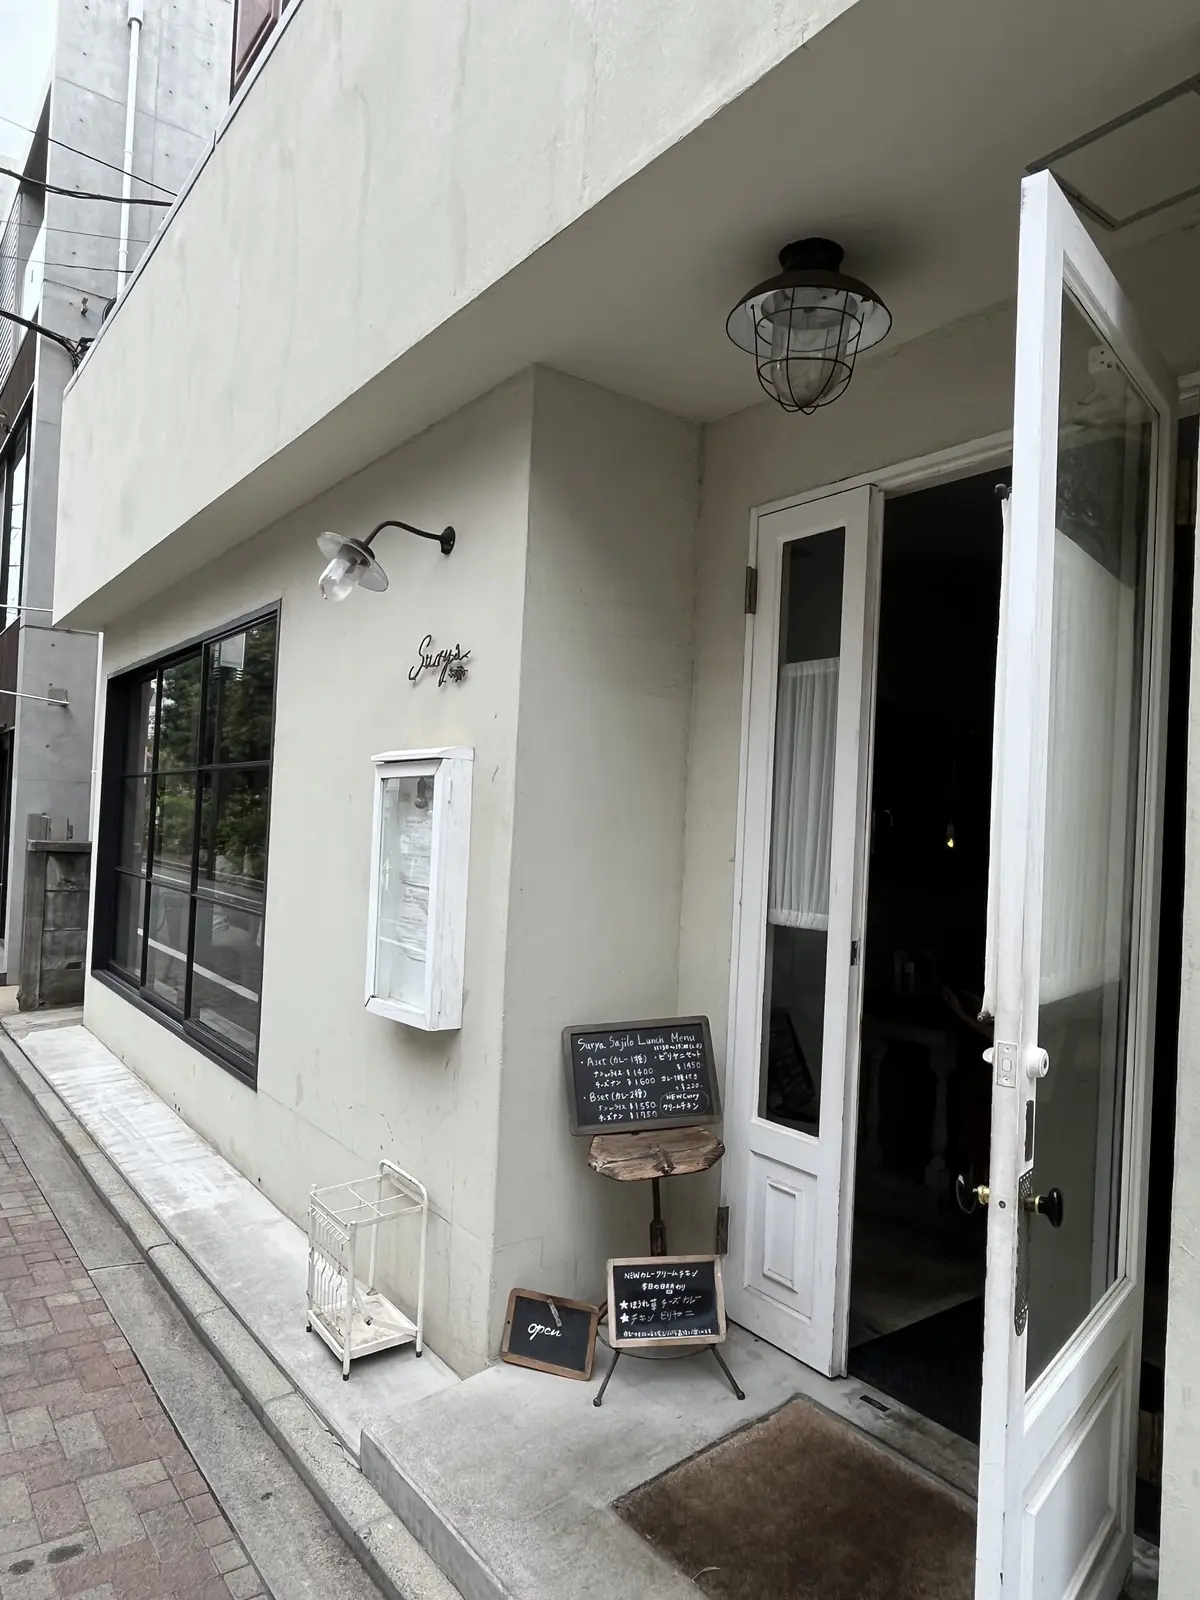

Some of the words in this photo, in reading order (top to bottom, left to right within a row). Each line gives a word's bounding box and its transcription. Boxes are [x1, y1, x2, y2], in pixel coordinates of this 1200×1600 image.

[577, 1038, 607, 1053] Surya
[609, 1034, 635, 1052] Sajilo
[637, 1033, 665, 1046] Lunch
[670, 1032, 696, 1043] Menu
[527, 1323, 562, 1341] open
